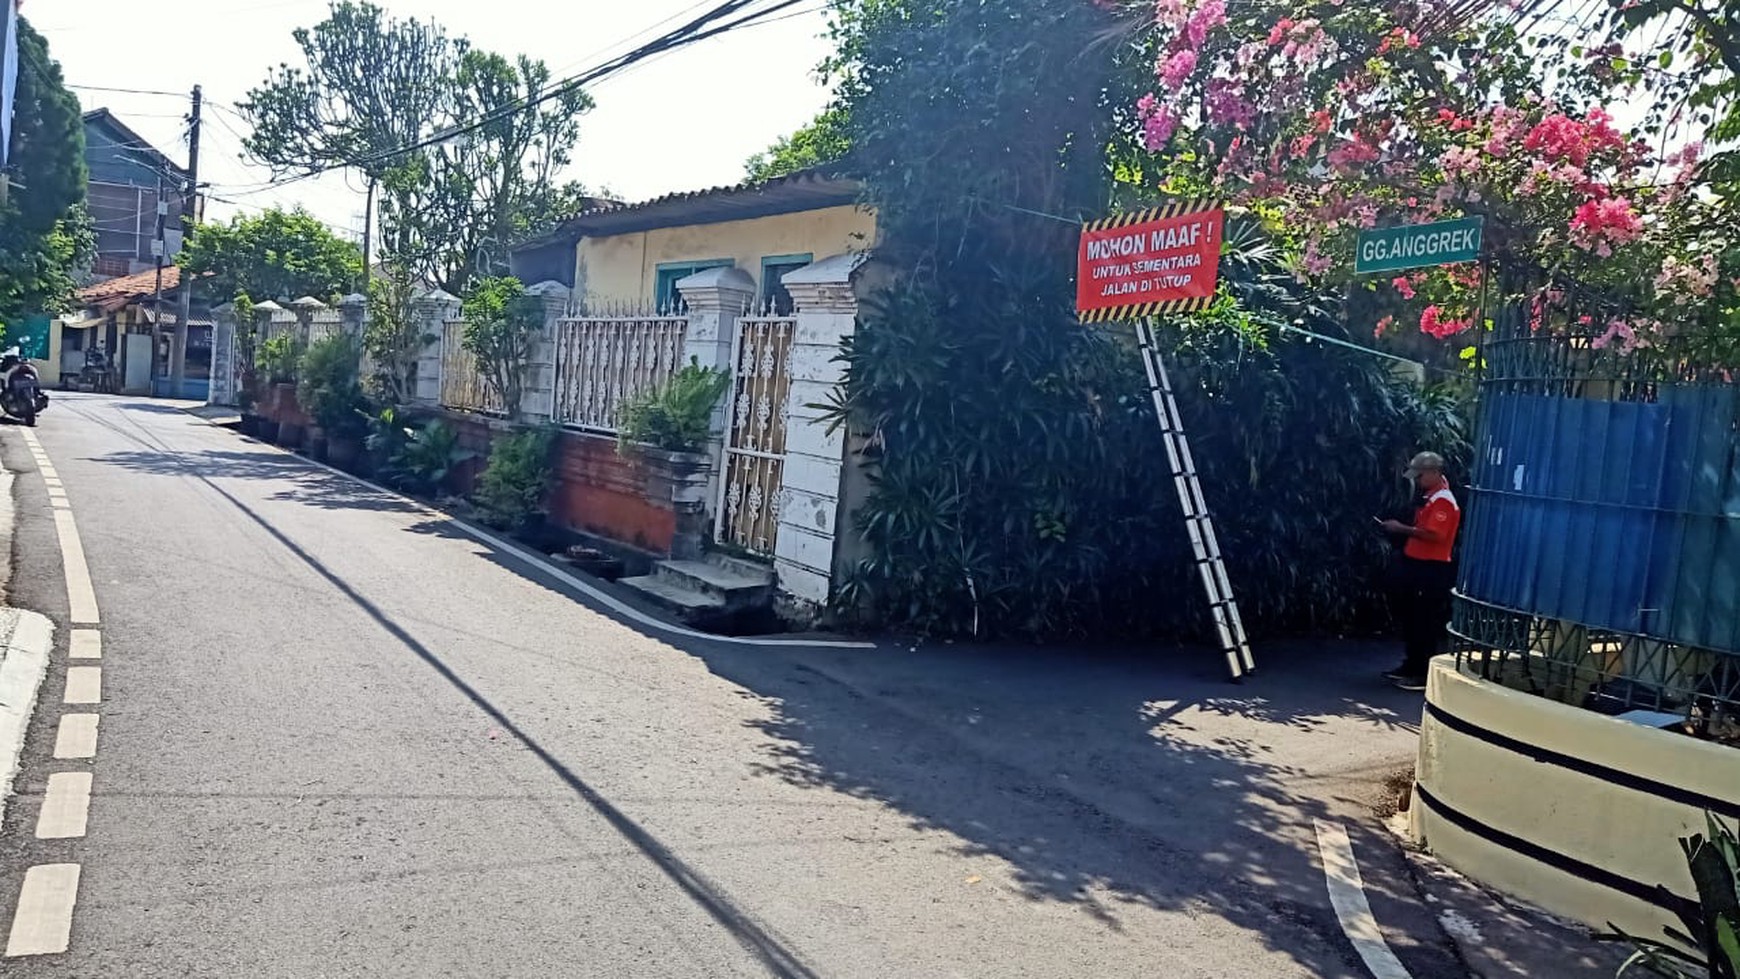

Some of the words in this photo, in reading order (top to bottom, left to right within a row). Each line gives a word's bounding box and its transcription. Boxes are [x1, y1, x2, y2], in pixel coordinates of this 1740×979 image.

[1087, 235, 1146, 261] MOHON
[1151, 223, 1201, 251] MAAF
[1206, 221, 1213, 243] !
[1363, 228, 1476, 261] GG.ANGGREK
[1092, 264, 1131, 279] UNTUK
[1133, 253, 1201, 273] SEMENTARA
[1101, 281, 1138, 296] JALAN
[1140, 281, 1152, 292] DI
[1155, 274, 1192, 289] TUTUP
